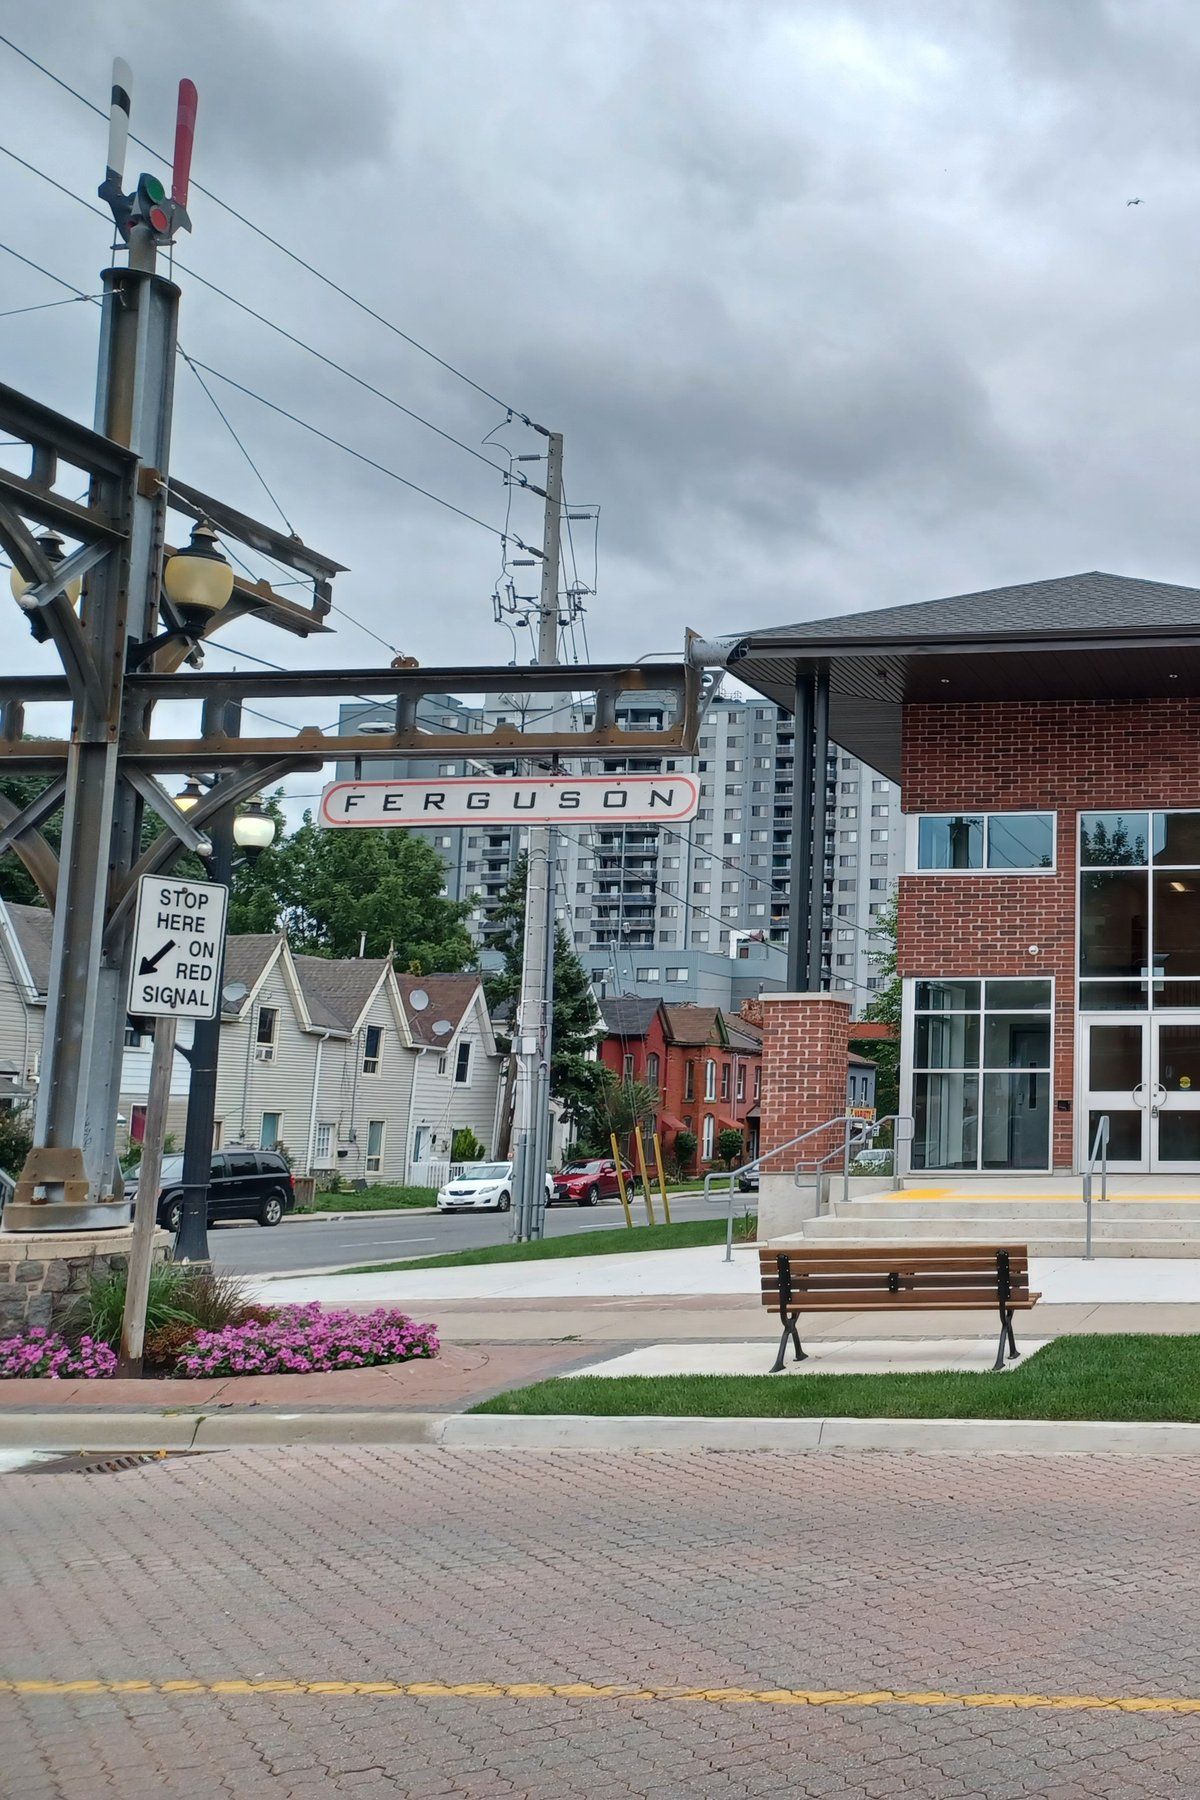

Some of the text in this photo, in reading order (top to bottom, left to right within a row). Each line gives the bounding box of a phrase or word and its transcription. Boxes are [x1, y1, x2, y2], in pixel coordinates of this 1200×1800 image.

[344, 789, 674, 812] FERGUSON
[160, 888, 209, 909] STOP
[157, 912, 206, 933] HERE
[189, 940, 214, 958] ON
[176, 963, 212, 981] RED
[142, 985, 209, 1006] SIGNAL
